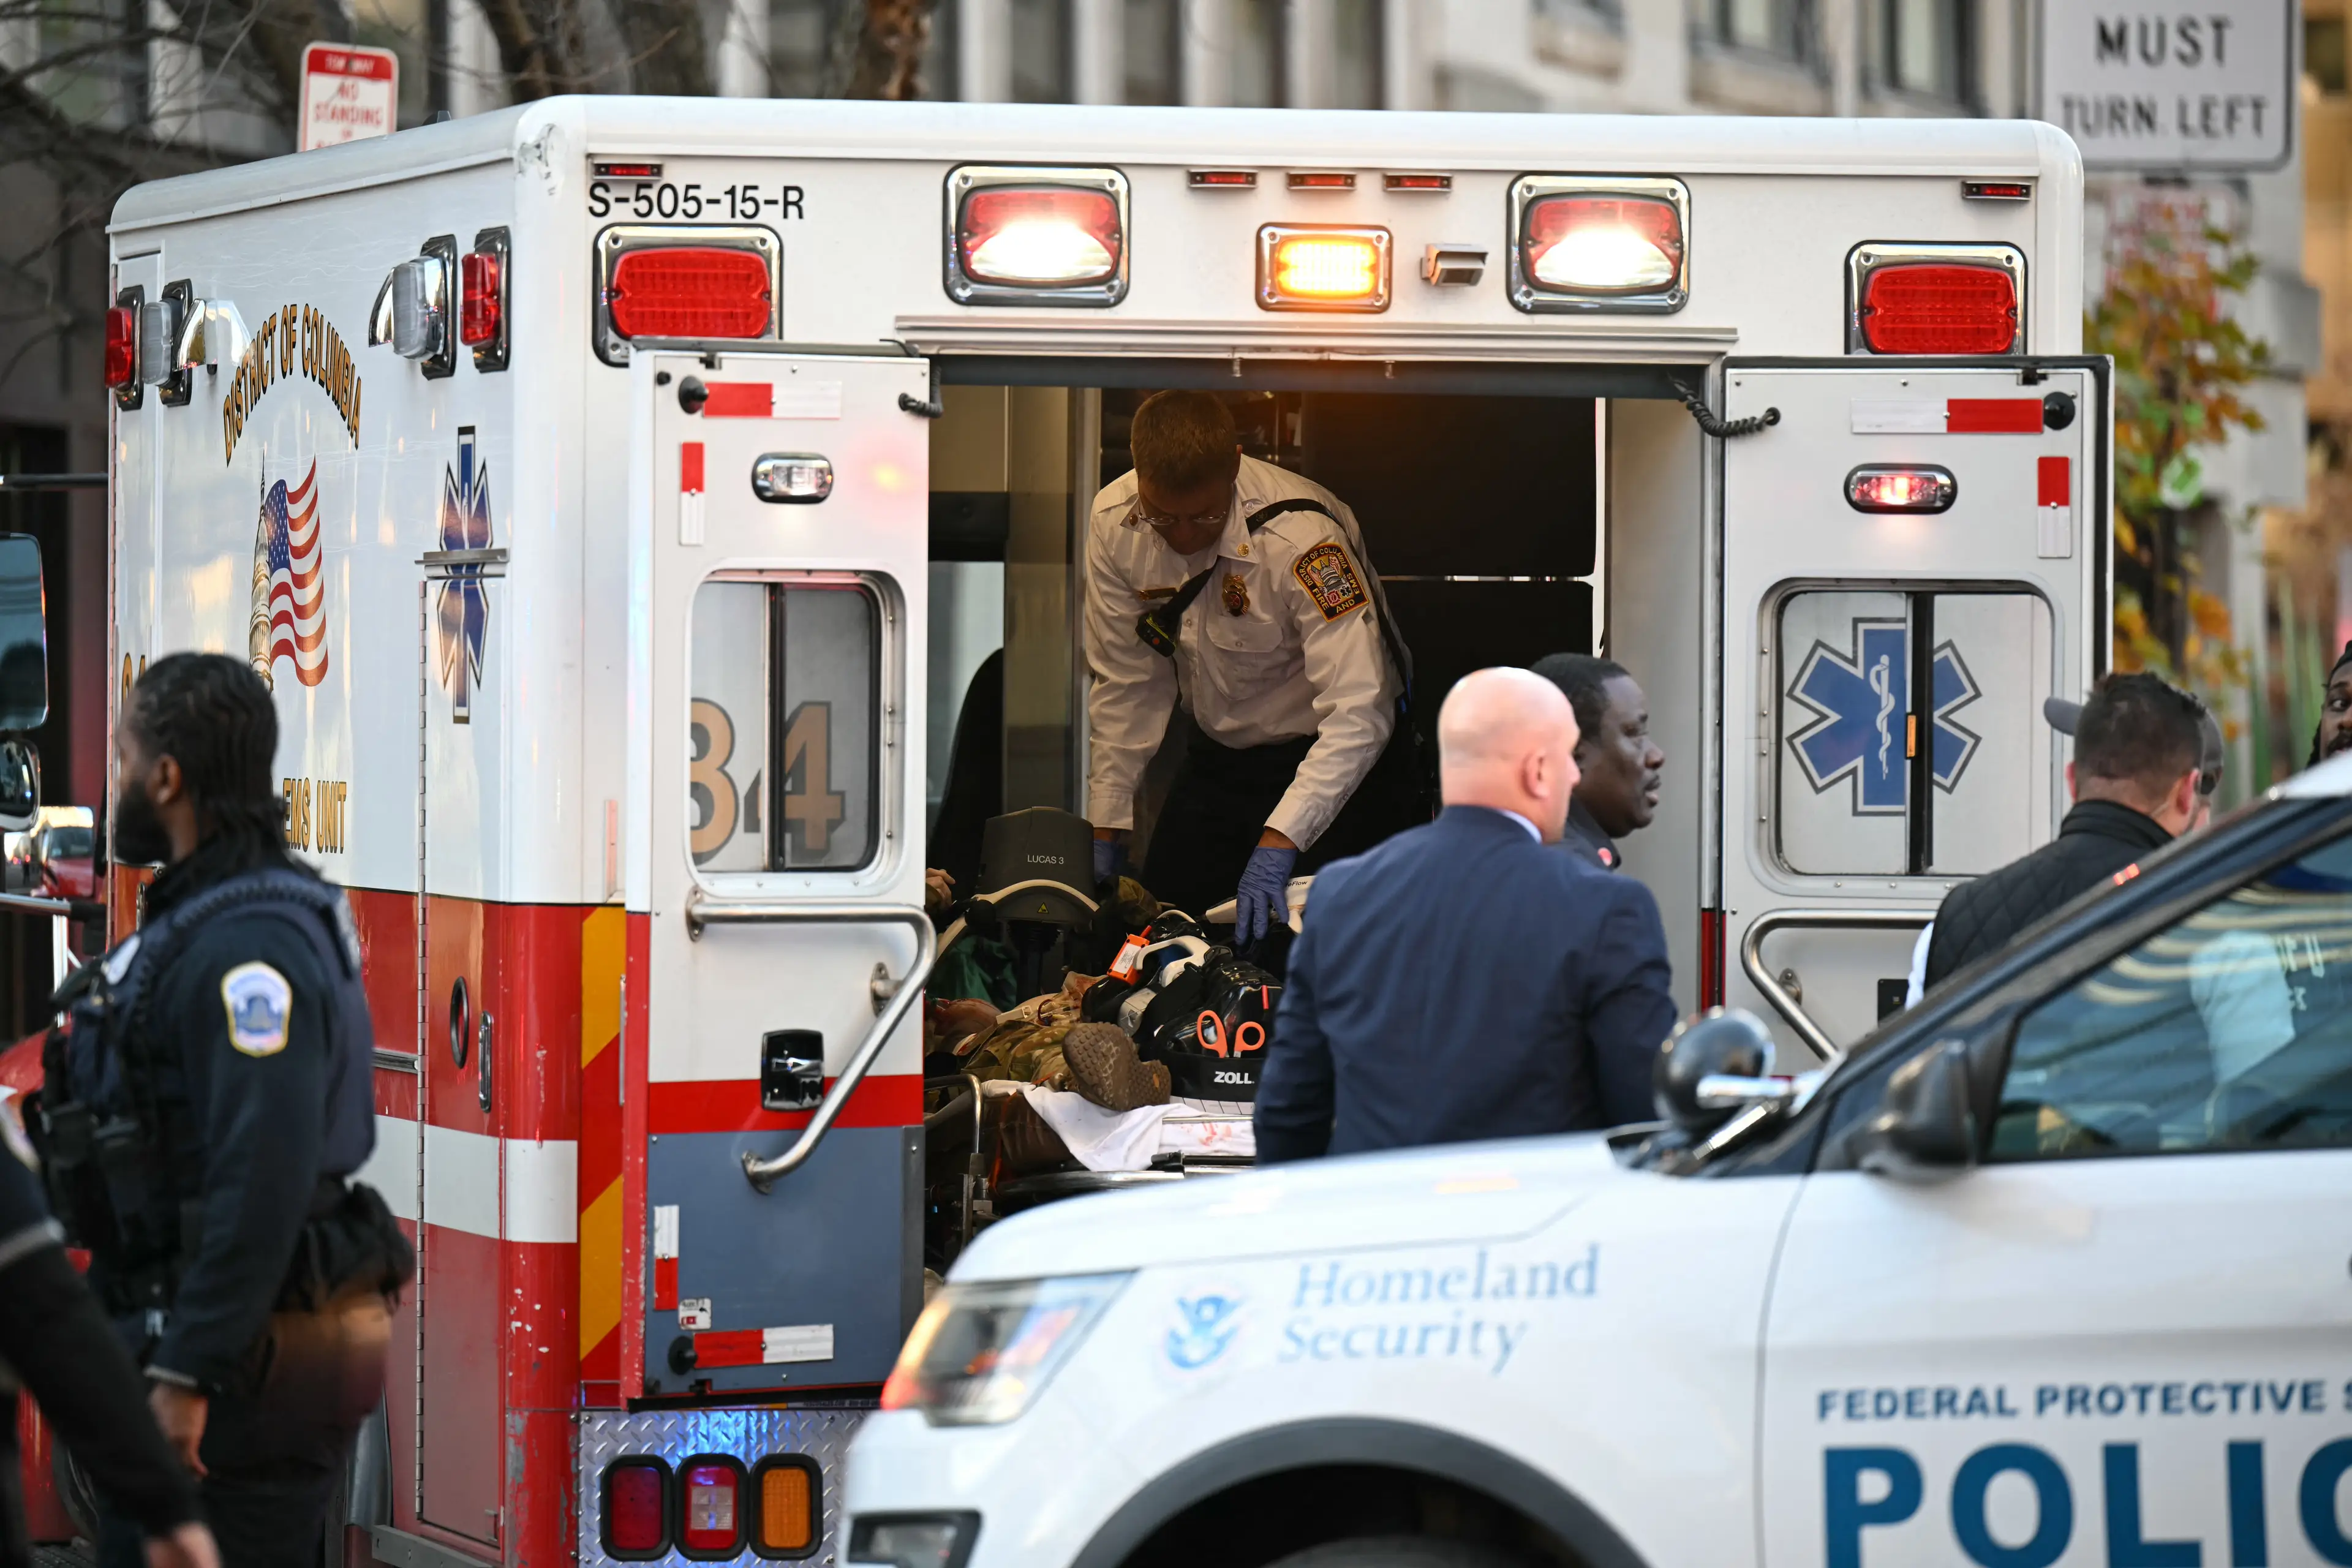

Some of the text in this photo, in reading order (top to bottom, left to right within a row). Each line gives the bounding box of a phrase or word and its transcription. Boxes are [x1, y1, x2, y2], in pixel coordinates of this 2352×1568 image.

[2094, 13, 2233, 69] MUST
[338, 81, 360, 101] NO
[315, 102, 382, 127] STANDING
[2059, 92, 2269, 140] TURN LEFT
[589, 183, 804, 219] S-505-15-R
[223, 303, 361, 467] DISTRICT OF COLUMBIA
[1299, 547, 1348, 586] DISTRICT OF COLUMBIA
[1346, 573, 1360, 595] EMS
[1312, 588, 1330, 610] FIRE
[1336, 599, 1355, 613] AND
[283, 777, 347, 854] EMS UNIT
[1027, 854, 1057, 864] LUCAS
[1214, 1071, 1253, 1084] ZOLL
[1292, 1242, 1600, 1307] Homeland
[1277, 1308, 1529, 1377] Security
[1817, 1386, 2021, 1422] FEDERAL
[2035, 1380, 2328, 1418] PROTECTIVE
